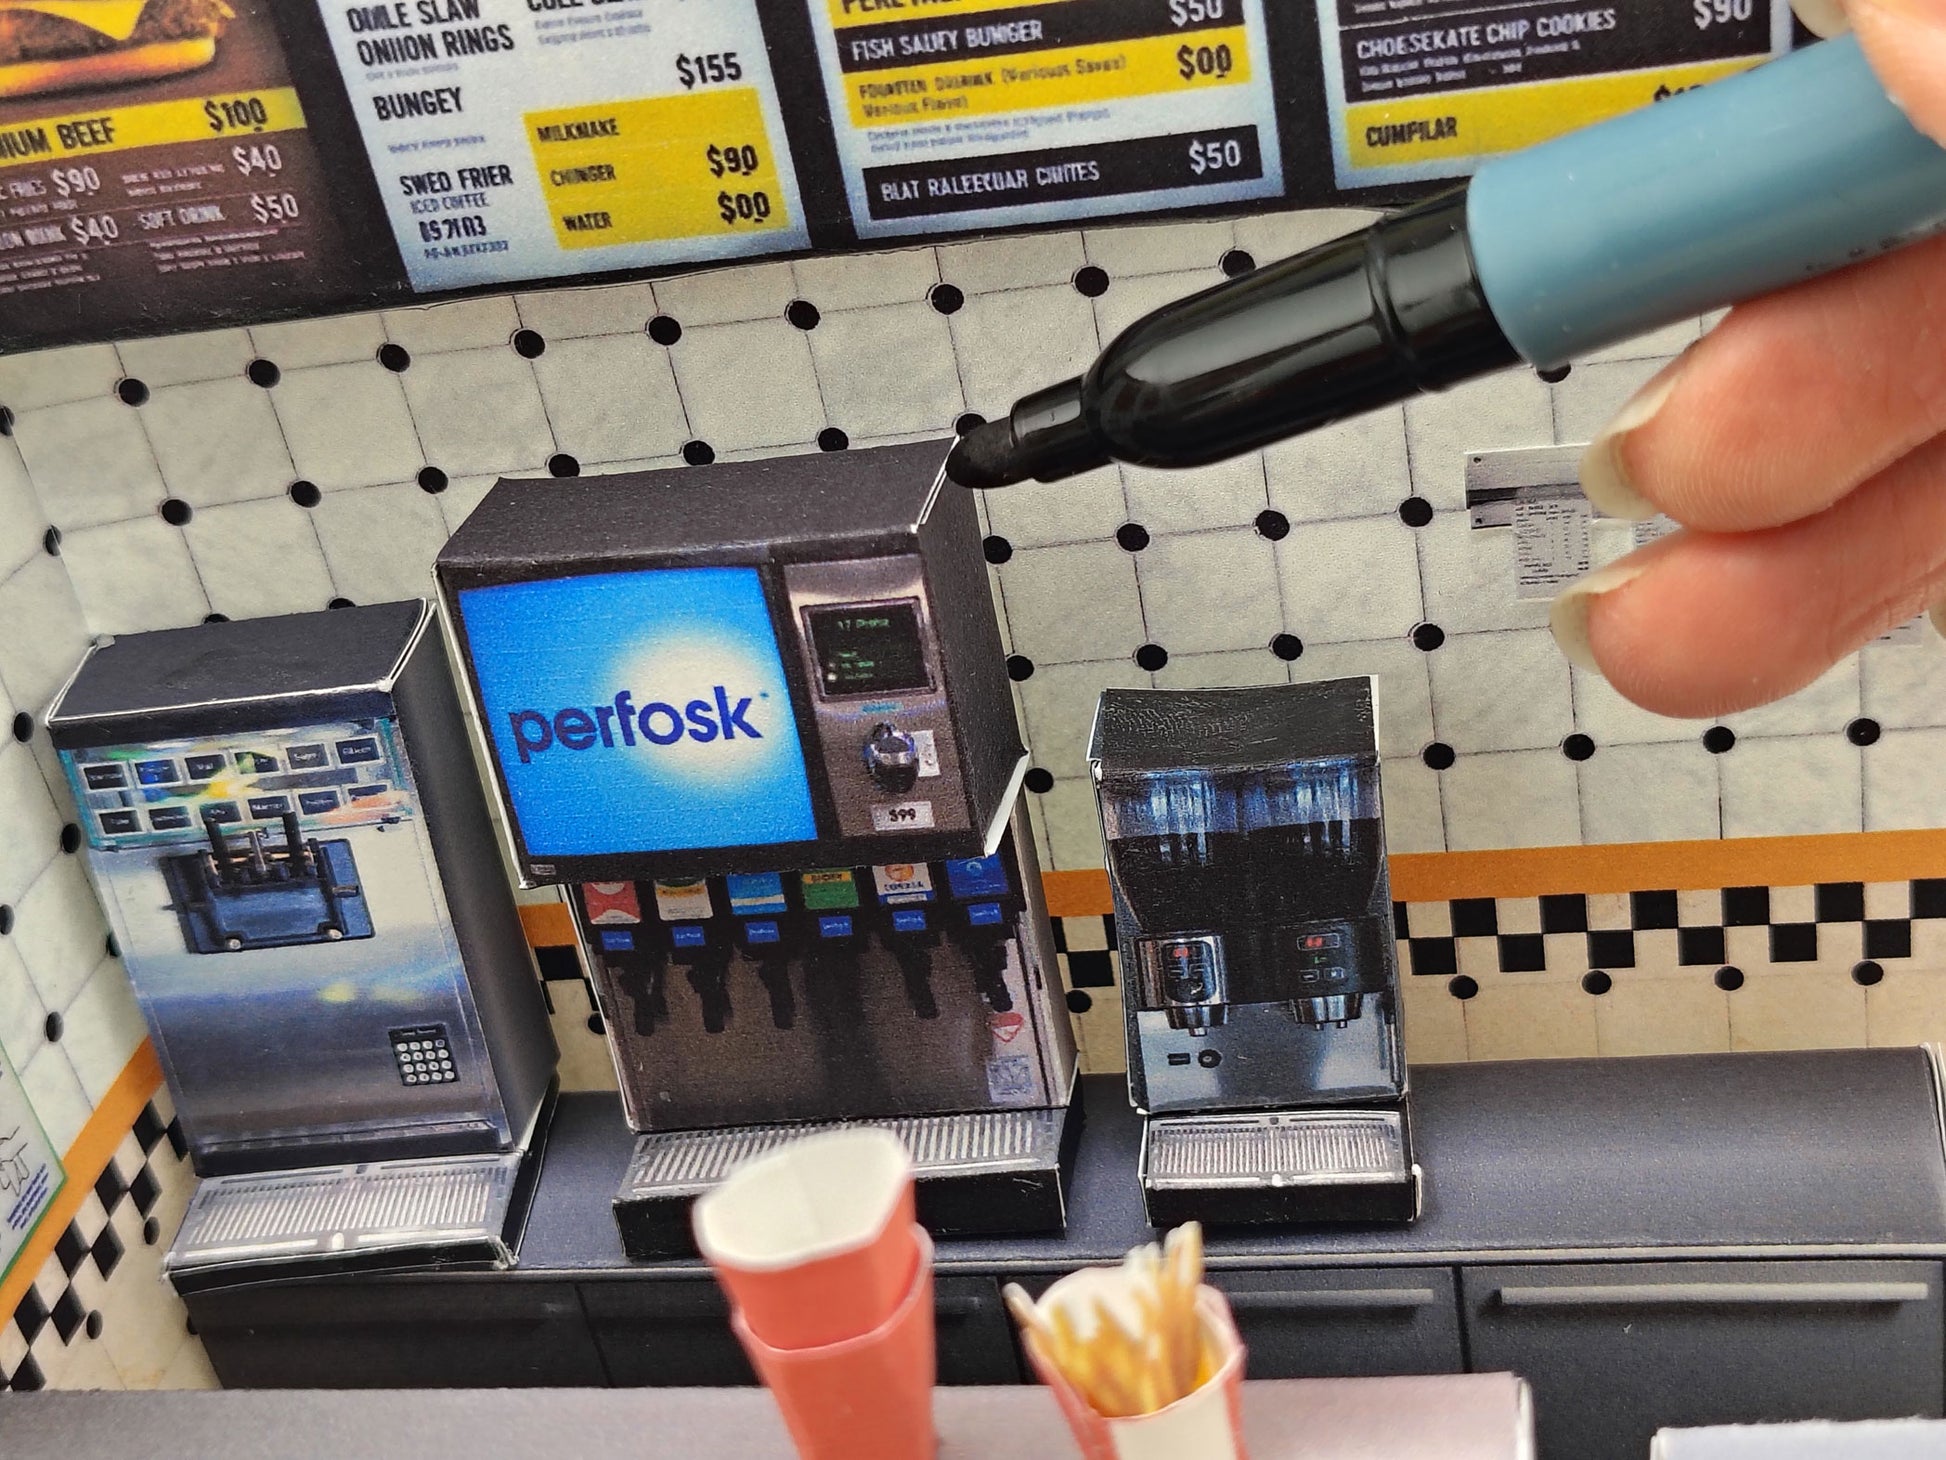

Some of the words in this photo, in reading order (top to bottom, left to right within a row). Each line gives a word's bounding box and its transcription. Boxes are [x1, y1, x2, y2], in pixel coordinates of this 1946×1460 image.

[417, 0, 480, 25] SLAW
[1168, 0, 1223, 27] $50
[1486, 19, 1531, 44] CHIP
[1536, 8, 1617, 38] COOKIES
[1694, 0, 1752, 30] $90
[441, 24, 515, 57] RINGS
[851, 38, 895, 62] FISH
[676, 52, 742, 90] $155
[1177, 43, 1232, 81] $00
[204, 97, 268, 132] $100
[373, 86, 463, 121] BUNGEY
[57, 116, 115, 149] BEEF
[232, 144, 282, 178] $40
[706, 144, 759, 178] $90
[1188, 139, 1241, 175] $50
[50, 165, 101, 198] $90
[457, 164, 514, 190] FRIER
[250, 192, 299, 224] $50
[562, 212, 613, 232] WATER
[717, 190, 771, 224] $00
[71, 214, 119, 246] $40
[508, 685, 763, 764] perfosk
